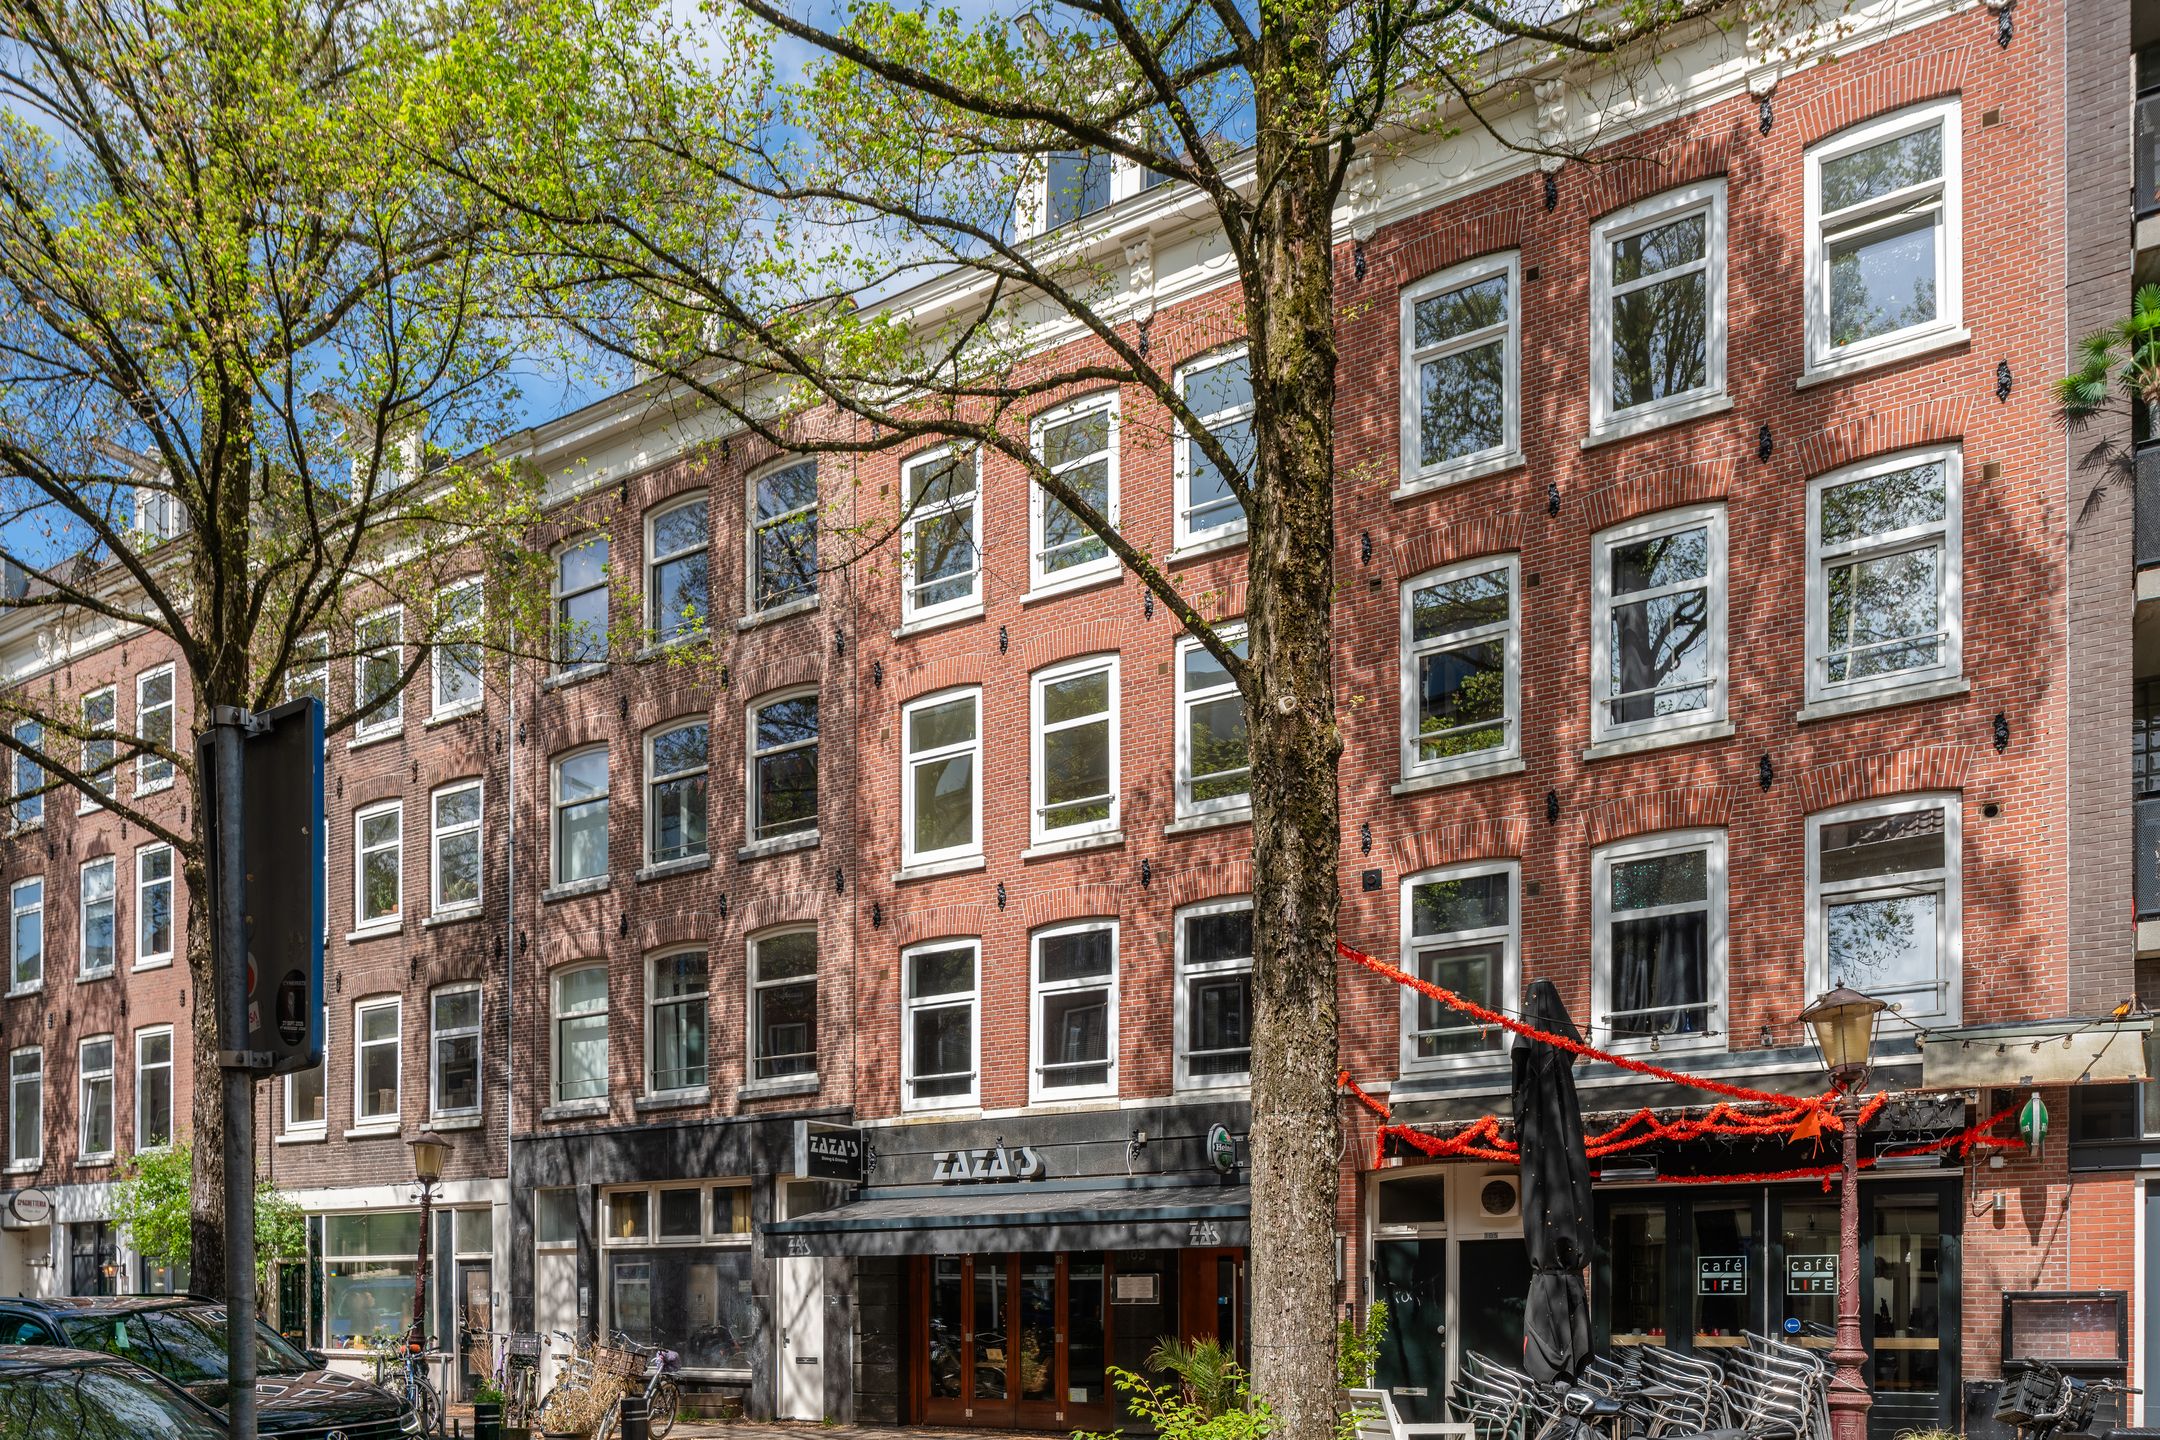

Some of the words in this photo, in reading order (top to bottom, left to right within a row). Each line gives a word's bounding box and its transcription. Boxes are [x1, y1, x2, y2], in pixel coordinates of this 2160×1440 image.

[810, 1136, 858, 1157] ZAZA'S
[933, 1147, 1037, 1180] ZAZA'S
[1702, 1259, 1742, 1272] café
[1791, 1257, 1834, 1271] café
[1701, 1279, 1742, 1292] LIFE
[1791, 1279, 1834, 1291] LIFE
